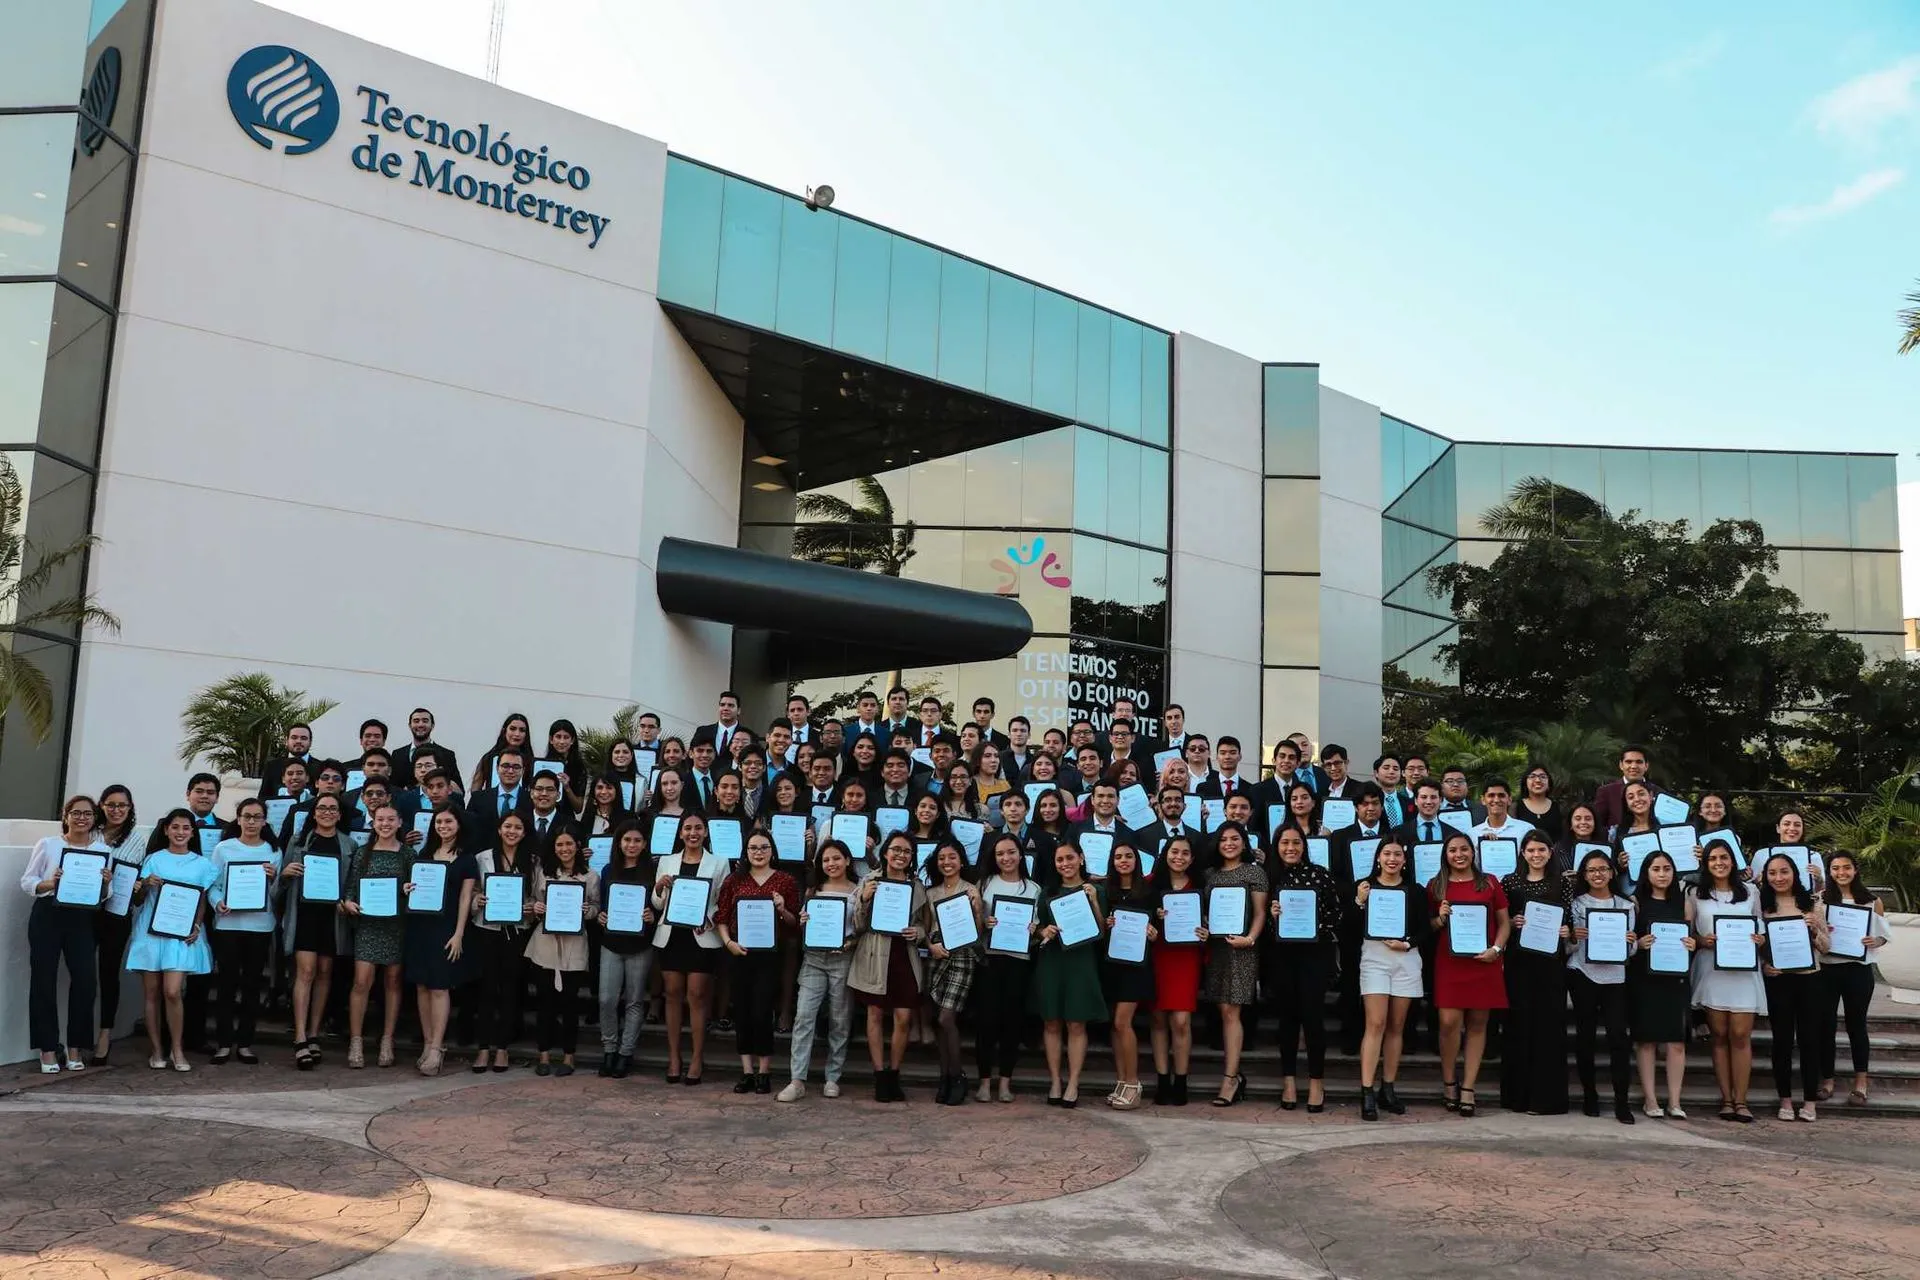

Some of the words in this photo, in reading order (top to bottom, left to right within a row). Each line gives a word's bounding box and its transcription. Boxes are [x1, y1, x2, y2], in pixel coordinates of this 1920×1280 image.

[357, 84, 592, 191] Tecnológico
[351, 133, 404, 179] de
[409, 149, 611, 250] Monterrey
[1021, 651, 1118, 680] TENEMOS
[1018, 679, 1082, 702] OTRO
[1023, 705, 1158, 738] ESPEÁNTE
